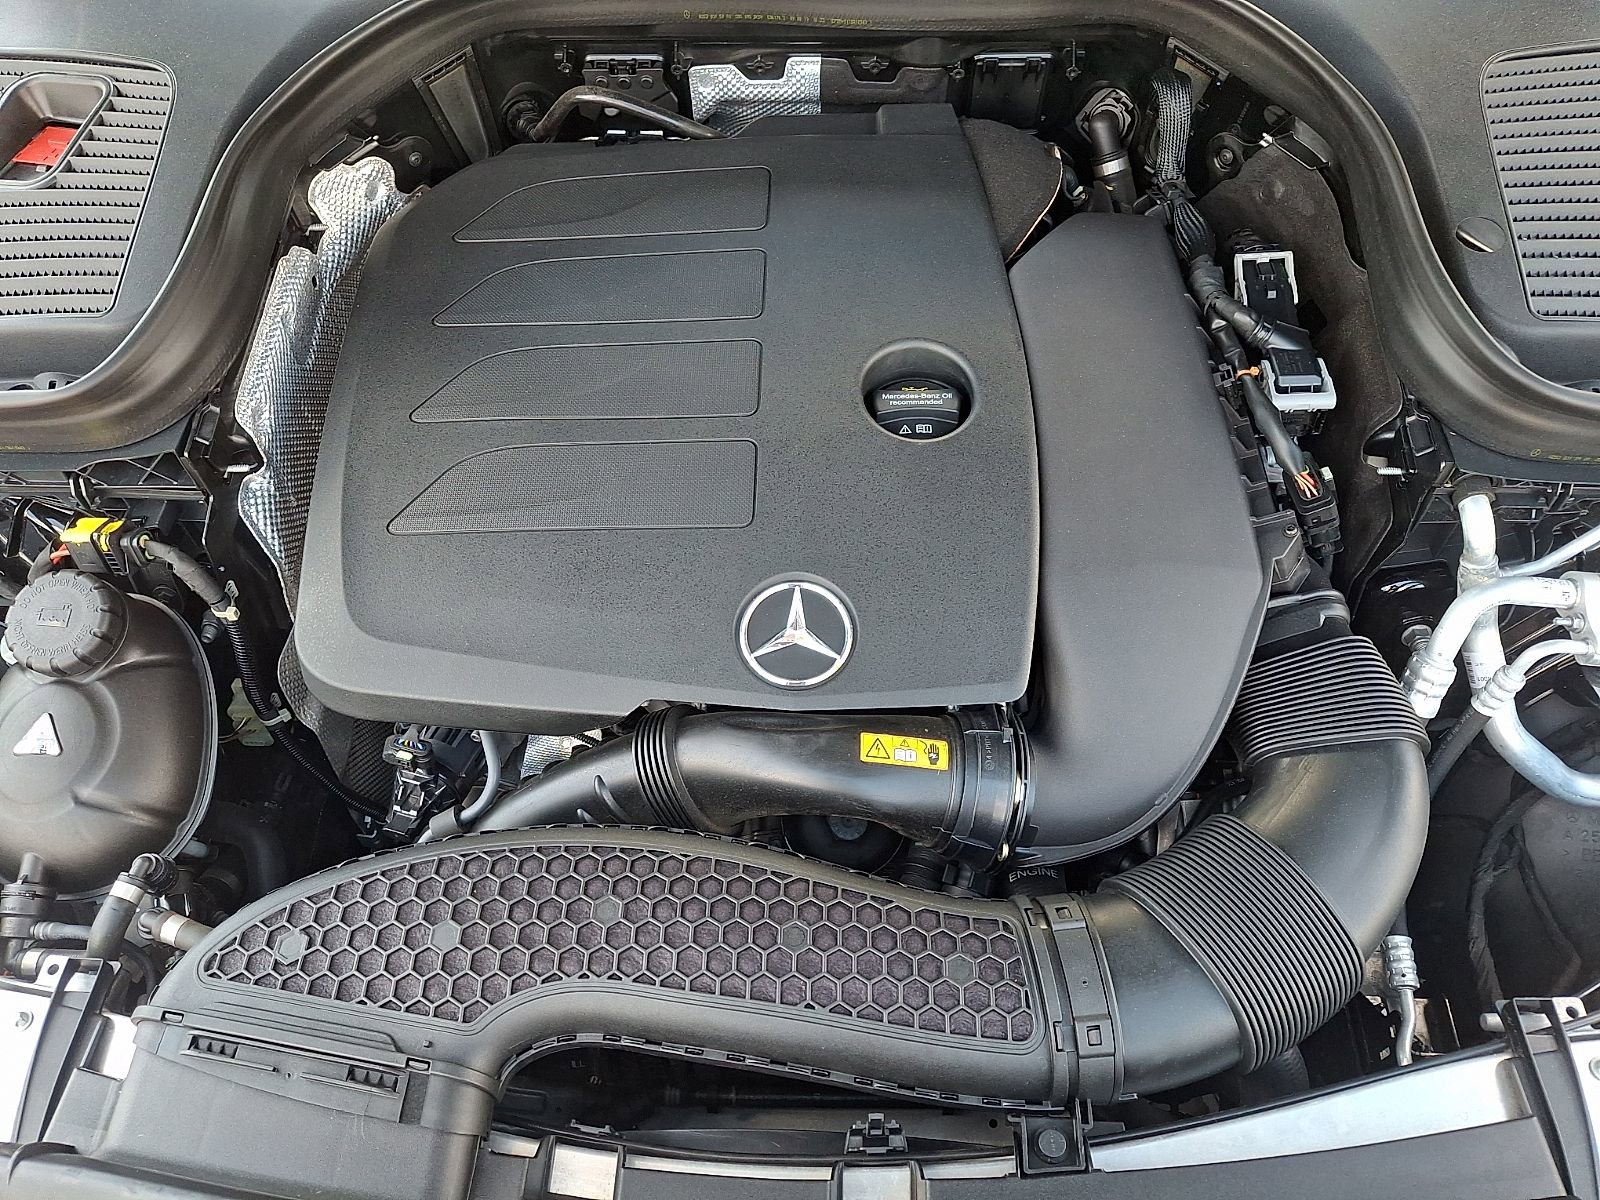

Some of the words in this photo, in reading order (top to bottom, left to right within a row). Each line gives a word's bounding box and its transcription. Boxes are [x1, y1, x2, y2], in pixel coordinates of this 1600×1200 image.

[31, 583, 47, 598] NOT
[48, 578, 71, 588] OPEN
[1008, 866, 1059, 882] ENGINE
